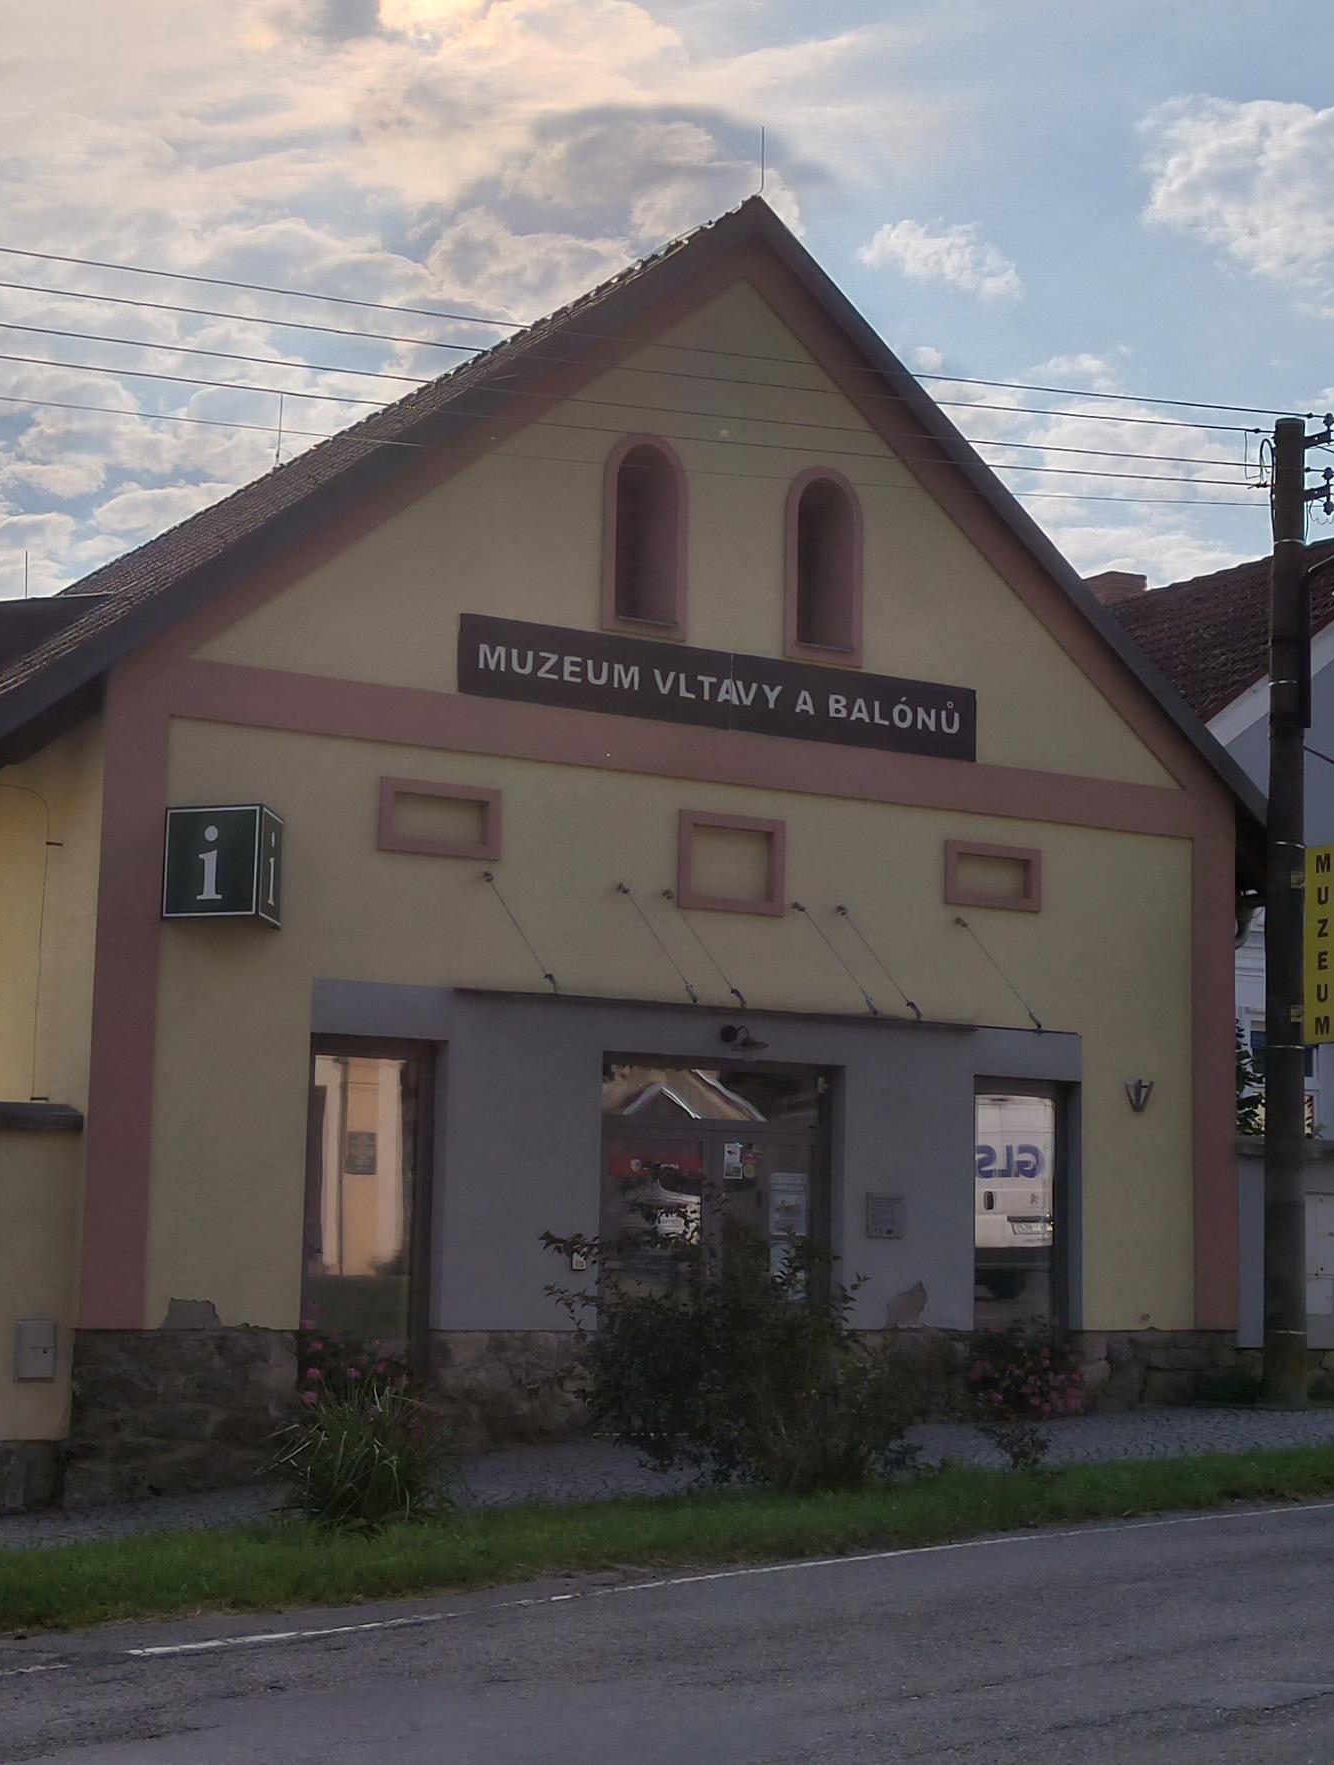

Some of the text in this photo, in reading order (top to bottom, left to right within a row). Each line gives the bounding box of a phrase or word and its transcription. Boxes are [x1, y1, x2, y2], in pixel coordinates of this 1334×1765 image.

[478, 642, 961, 735] MUZEUM VLTAVY A BALÓNŮ
[195, 824, 223, 901] i
[1314, 852, 1332, 1036] MUZEUM
